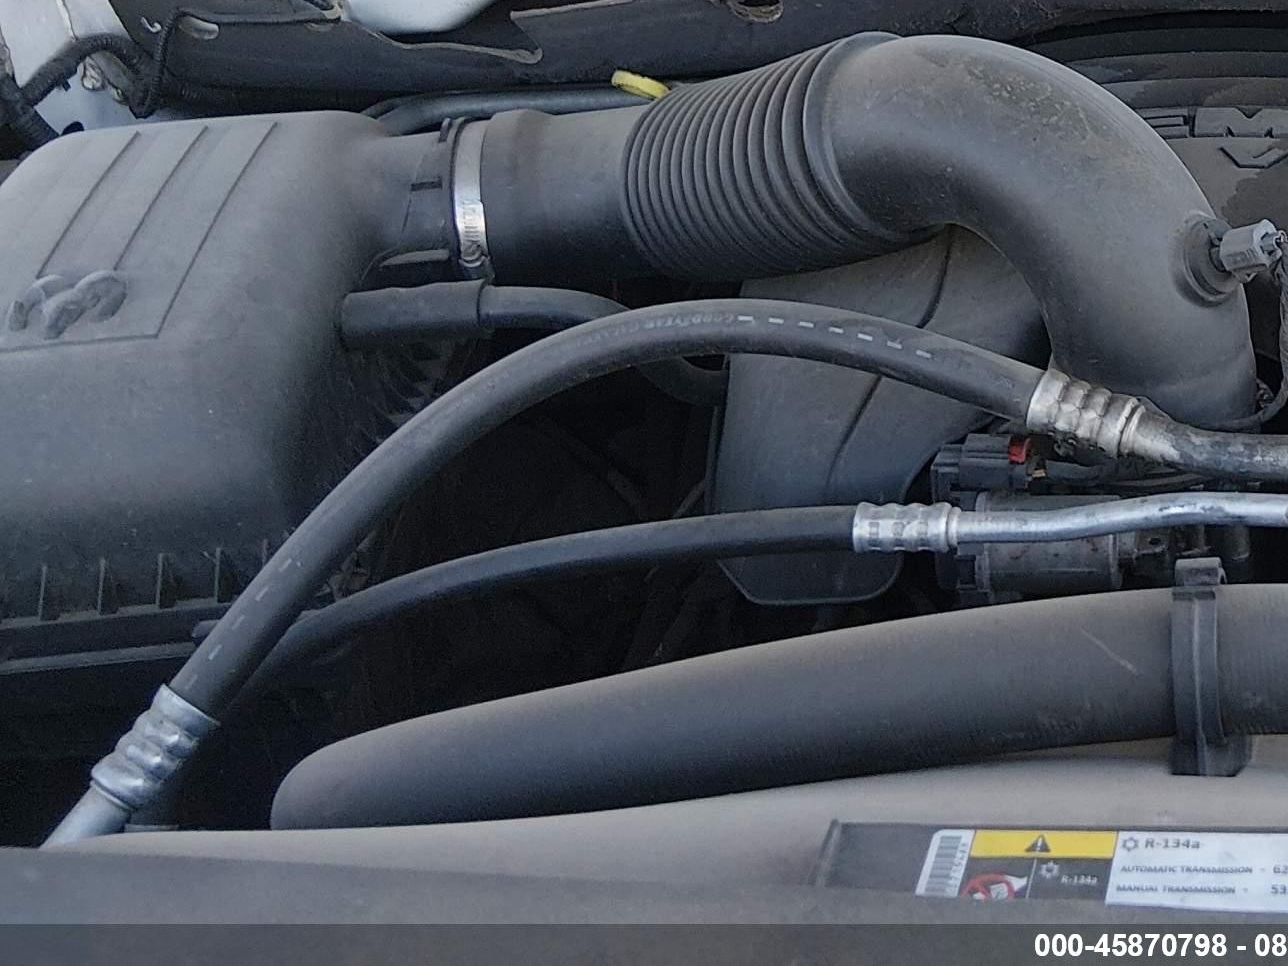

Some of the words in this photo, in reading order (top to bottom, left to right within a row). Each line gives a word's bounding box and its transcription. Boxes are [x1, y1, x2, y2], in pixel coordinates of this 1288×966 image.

[1144, 837, 1201, 850] R-134a
[1120, 865, 1177, 874] AUTOMATIC
[1180, 865, 1253, 875] TRANSMISSION
[1061, 874, 1098, 885] R-134a
[1116, 884, 1159, 893] MANUAL
[1162, 884, 1236, 894] TRANSMISSION
